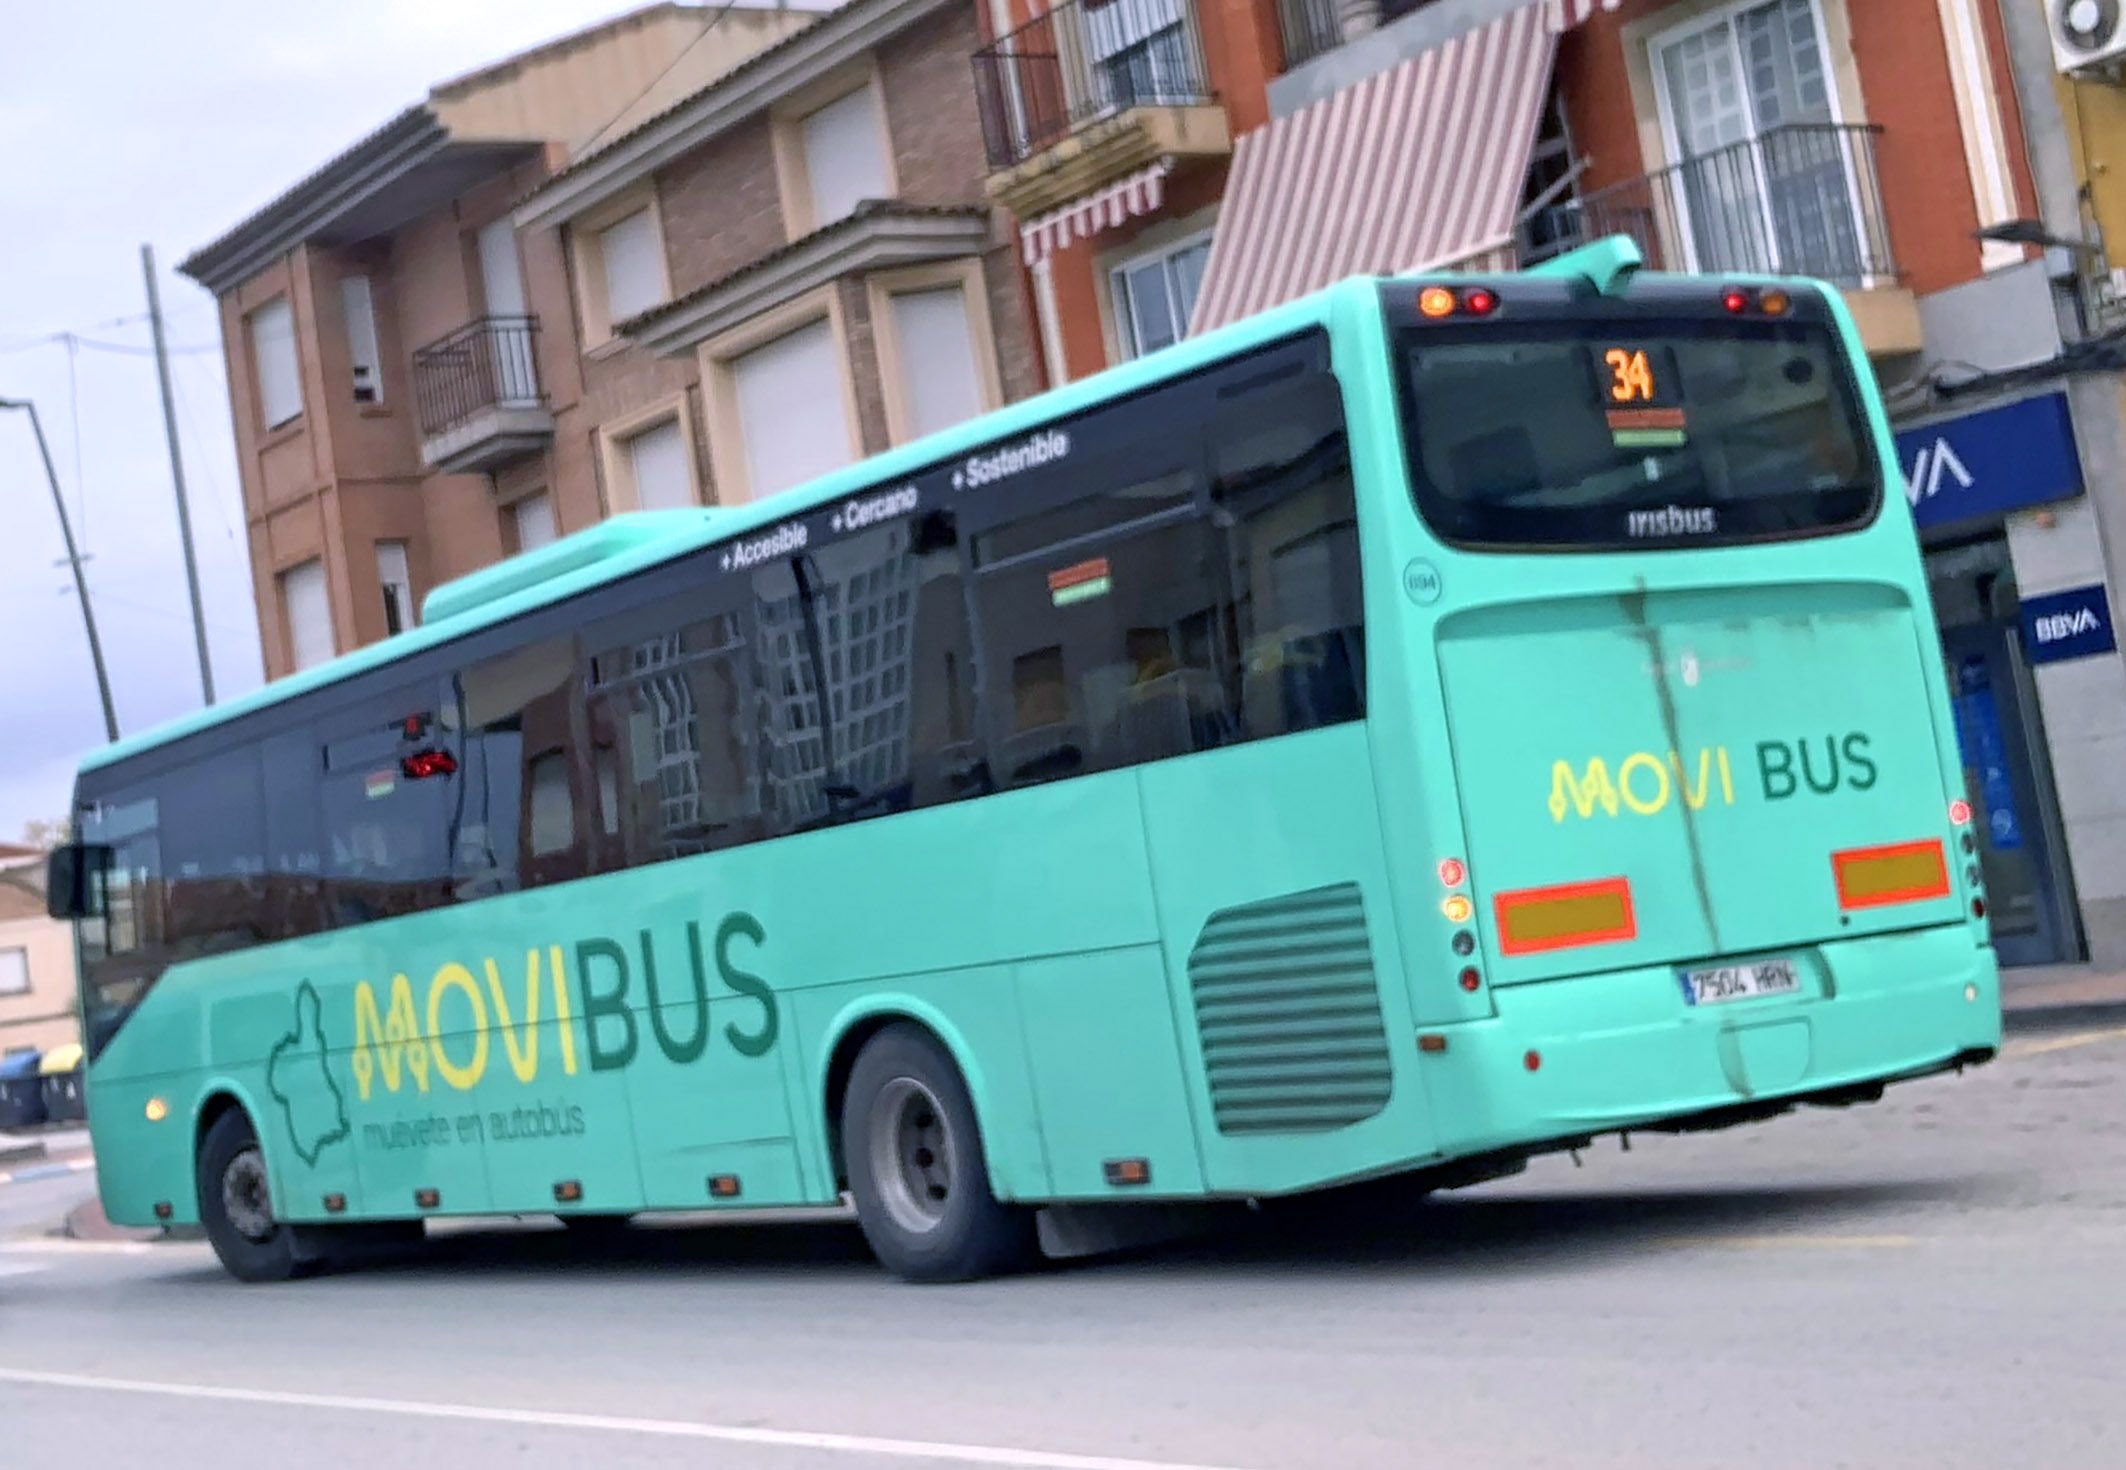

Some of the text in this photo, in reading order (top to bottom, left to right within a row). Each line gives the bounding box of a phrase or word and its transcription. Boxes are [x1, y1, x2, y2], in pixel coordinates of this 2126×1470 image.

[1605, 349, 1653, 400] 34
[2035, 607, 2101, 643] BBVA
[1548, 731, 1878, 823] MOVI BUS
